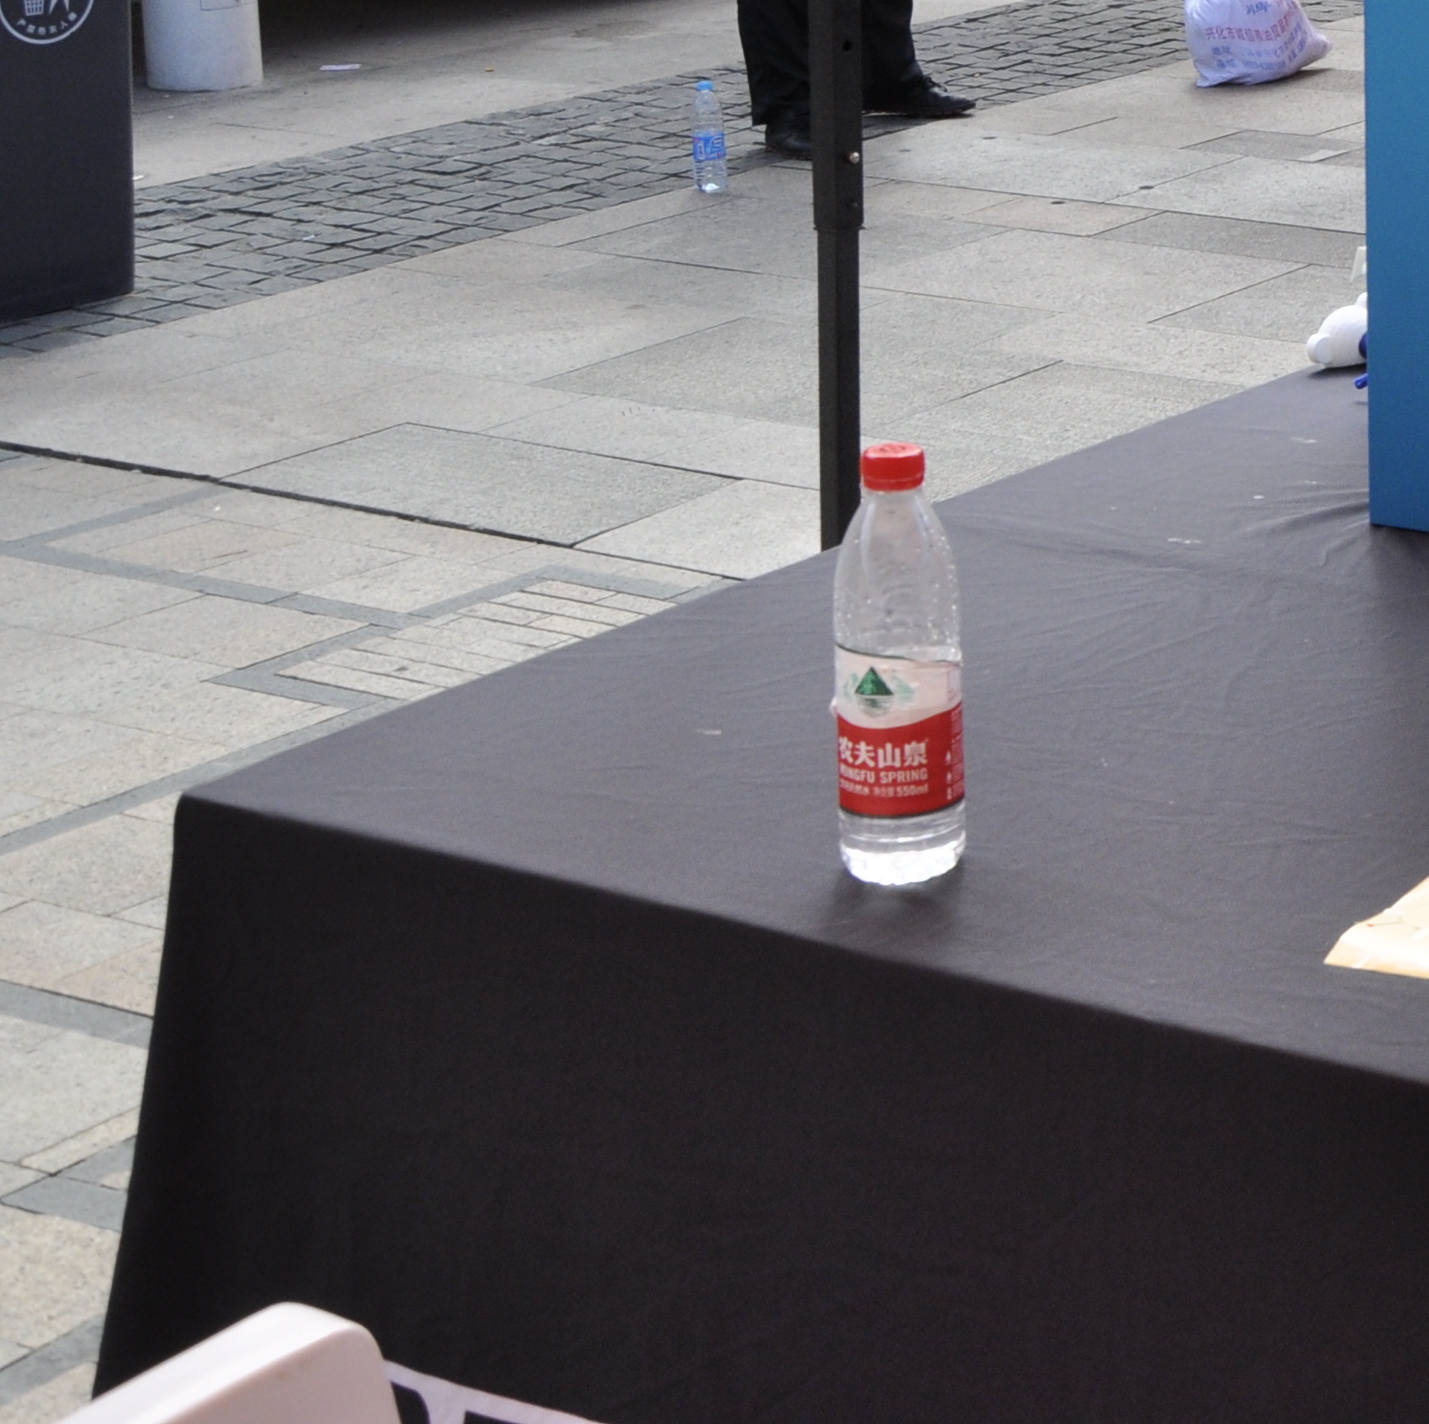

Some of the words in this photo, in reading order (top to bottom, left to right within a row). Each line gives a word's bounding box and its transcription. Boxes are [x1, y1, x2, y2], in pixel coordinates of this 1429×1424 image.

[838, 736, 928, 768] 农夫山泉
[880, 767, 928, 784] SPRING
